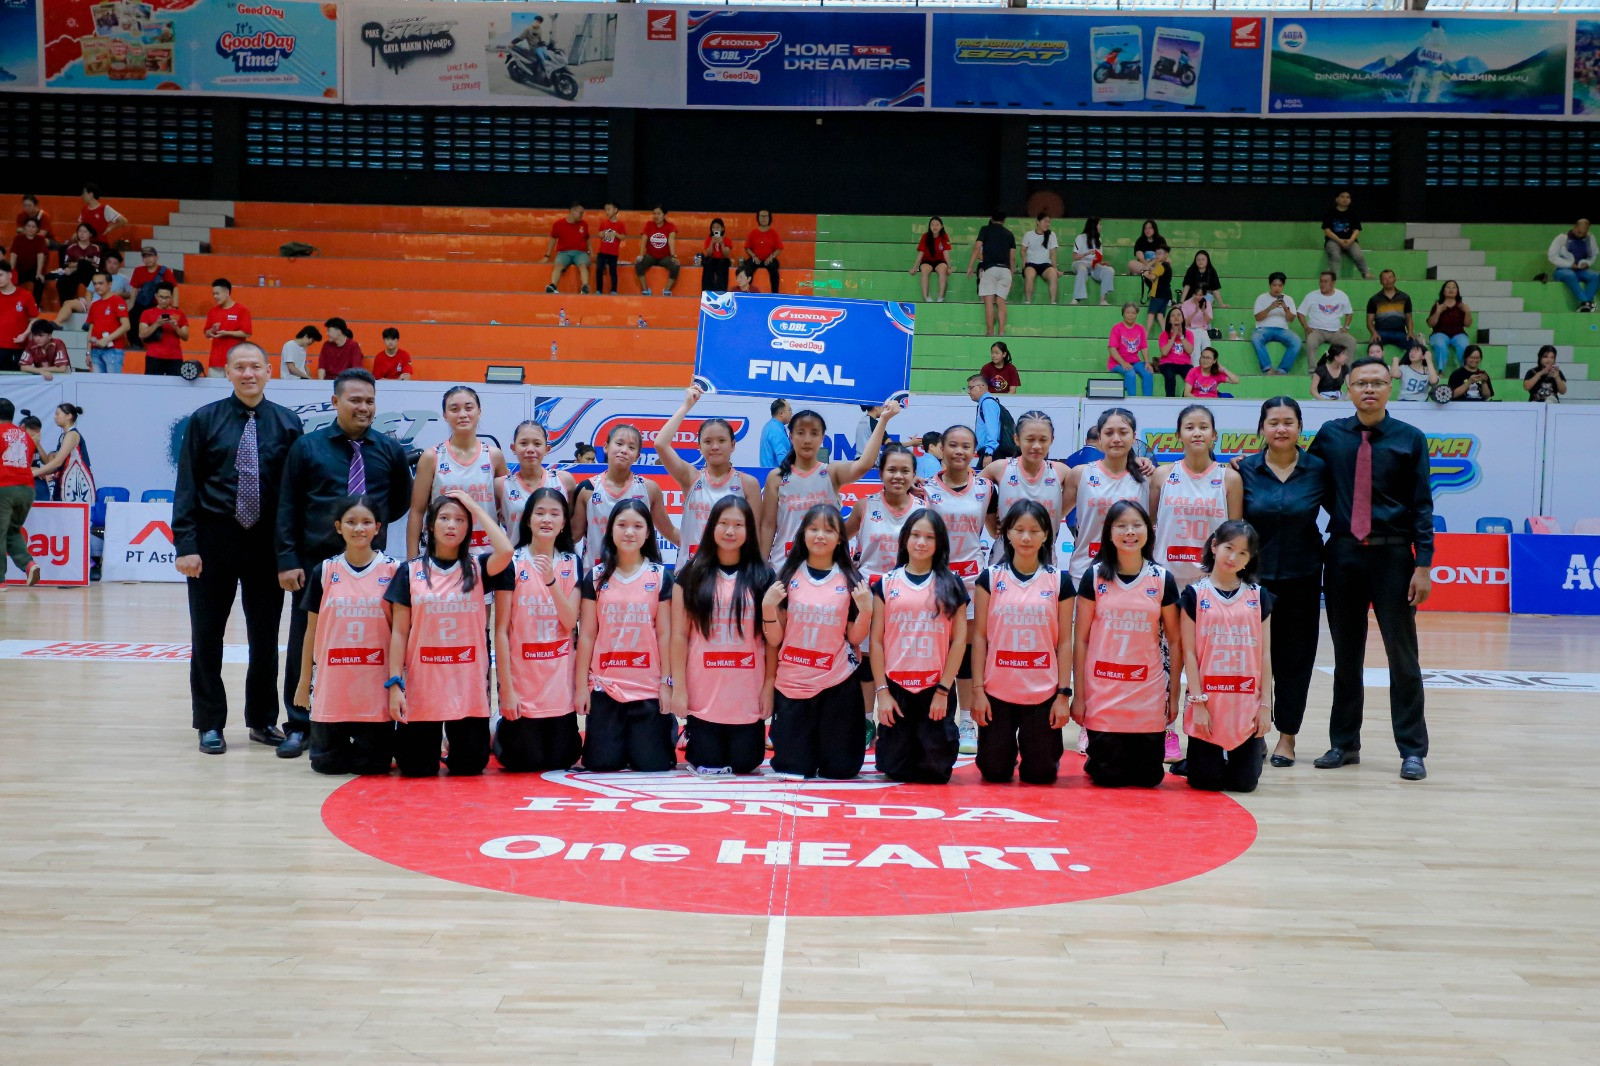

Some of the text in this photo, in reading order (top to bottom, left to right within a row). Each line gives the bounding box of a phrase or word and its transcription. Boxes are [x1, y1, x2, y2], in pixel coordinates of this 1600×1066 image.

[264, 6, 284, 19] Day
[236, 22, 253, 34] It's
[365, 29, 380, 38] PAKE
[1282, 31, 1303, 39] AQUA
[221, 31, 295, 53] Good Day
[383, 43, 399, 54] GAYA
[400, 41, 422, 52] MAKIN
[721, 51, 740, 60] DBL
[784, 44, 850, 56] HOME
[1420, 50, 1443, 61] AQUA
[236, 50, 280, 67] Time!
[784, 58, 911, 70] DREAMERS
[743, 72, 758, 81] Day
[1450, 73, 1497, 82] ADEMIN
[790, 313, 828, 321] HONDA
[788, 322, 807, 332] DBL
[808, 342, 823, 351] Day
[748, 359, 855, 387] FINAL
[1165, 496, 1217, 508] KALAM
[1173, 506, 1225, 518] KUDUS
[942, 513, 977, 524] ALAM
[1176, 519, 1209, 541] 30
[951, 536, 966, 555] 7
[126, 551, 176, 563] PT Ast
[1430, 565, 1510, 585] OND
[326, 596, 381, 607] KALAM
[413, 592, 472, 605] KALAM
[518, 595, 556, 606] KALA
[336, 607, 385, 618] KUDUS
[426, 601, 479, 614] KUDUS
[528, 605, 557, 616] KUD
[994, 604, 1046, 616] KALAM
[794, 613, 841, 626] KUDUS
[346, 621, 365, 643] 9
[439, 617, 457, 640] 2
[900, 620, 945, 633] KUDUS
[1104, 620, 1152, 632] KUDUS
[611, 627, 641, 649] 27
[802, 627, 819, 648] 11
[1012, 628, 1037, 651] 13
[1211, 635, 1257, 647] KUDUS
[1114, 634, 1131, 657] 7
[784, 653, 793, 661] One
[998, 658, 1009, 666] One
[1212, 650, 1246, 673] 23
[1096, 669, 1106, 677] One
[514, 796, 1059, 823] HONDA
[479, 835, 1092, 873] One HEART.
